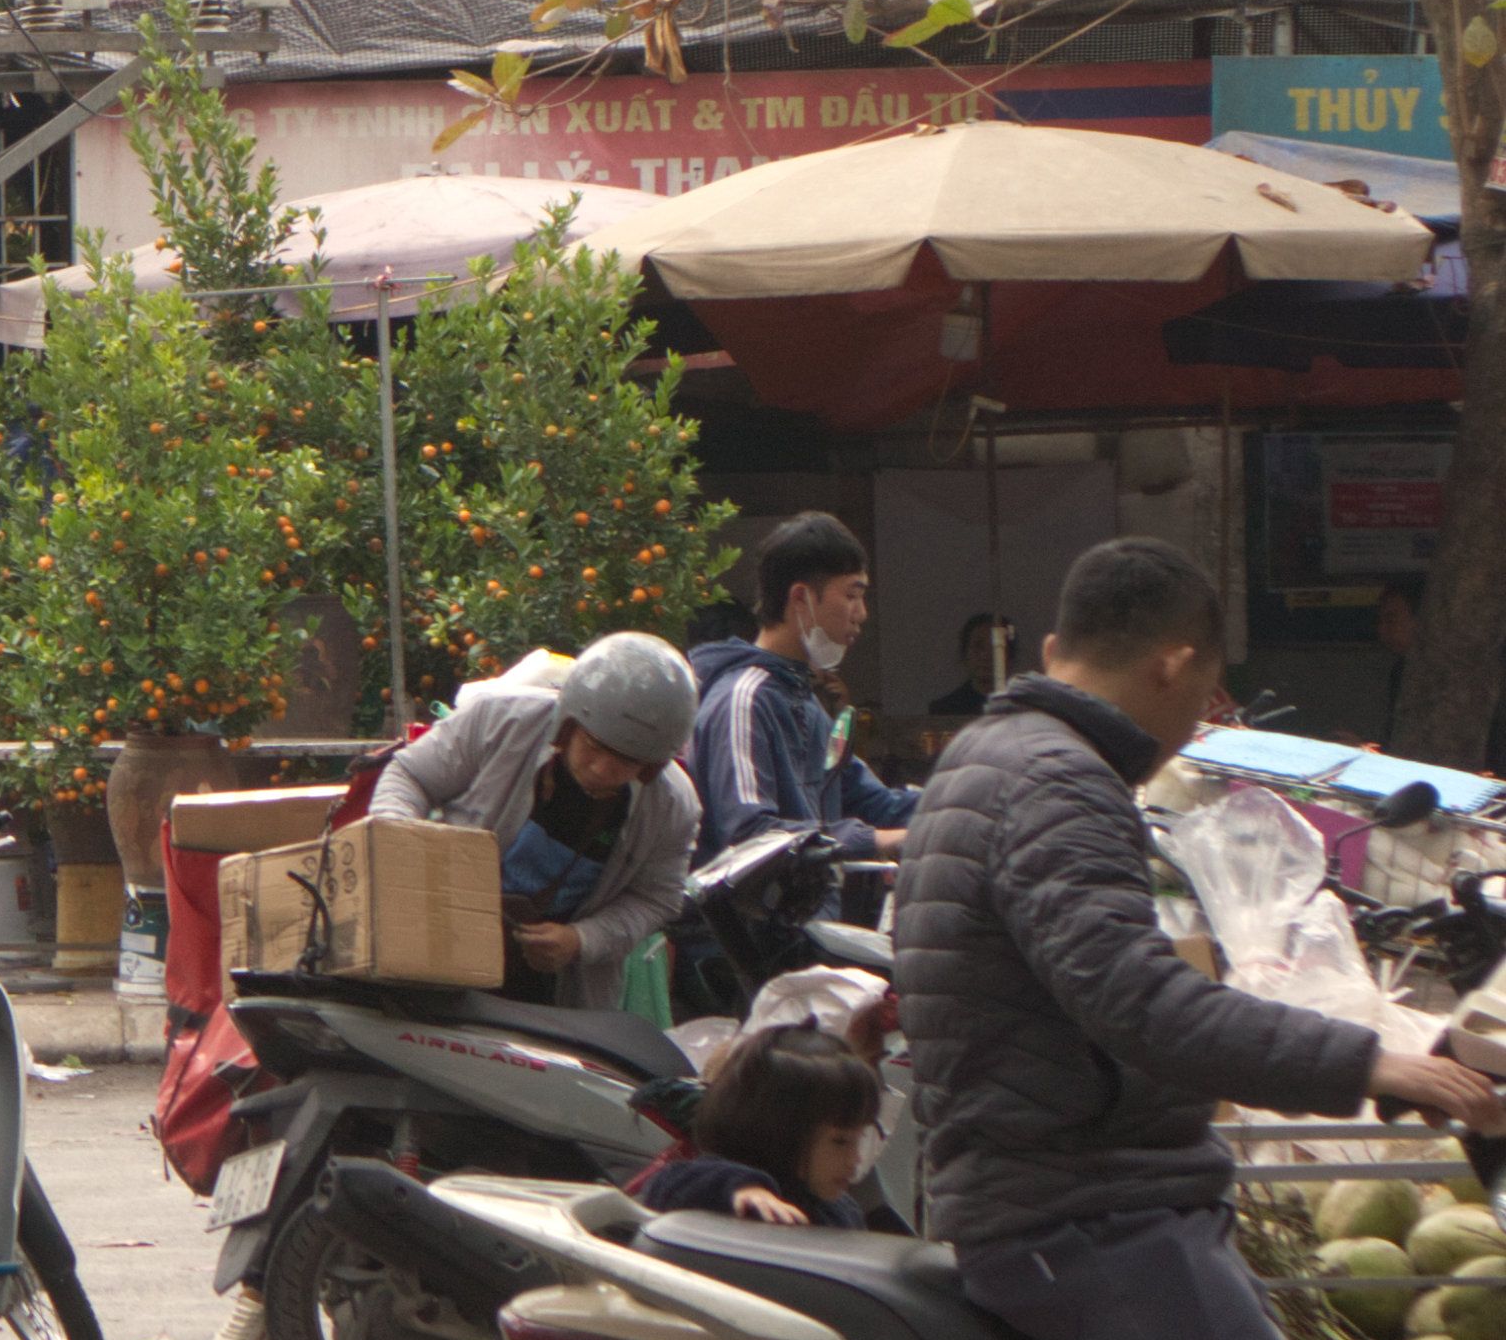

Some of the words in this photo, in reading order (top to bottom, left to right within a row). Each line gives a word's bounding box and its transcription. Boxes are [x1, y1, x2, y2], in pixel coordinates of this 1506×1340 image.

[332, 105, 446, 138] TNHH
[564, 88, 677, 134] XUẤT
[692, 97, 725, 130] &
[740, 96, 805, 130] TM
[820, 82, 911, 128] ĐẦU
[1287, 68, 1421, 132] THỦY
[396, 1031, 550, 1073] AIRBLADE
